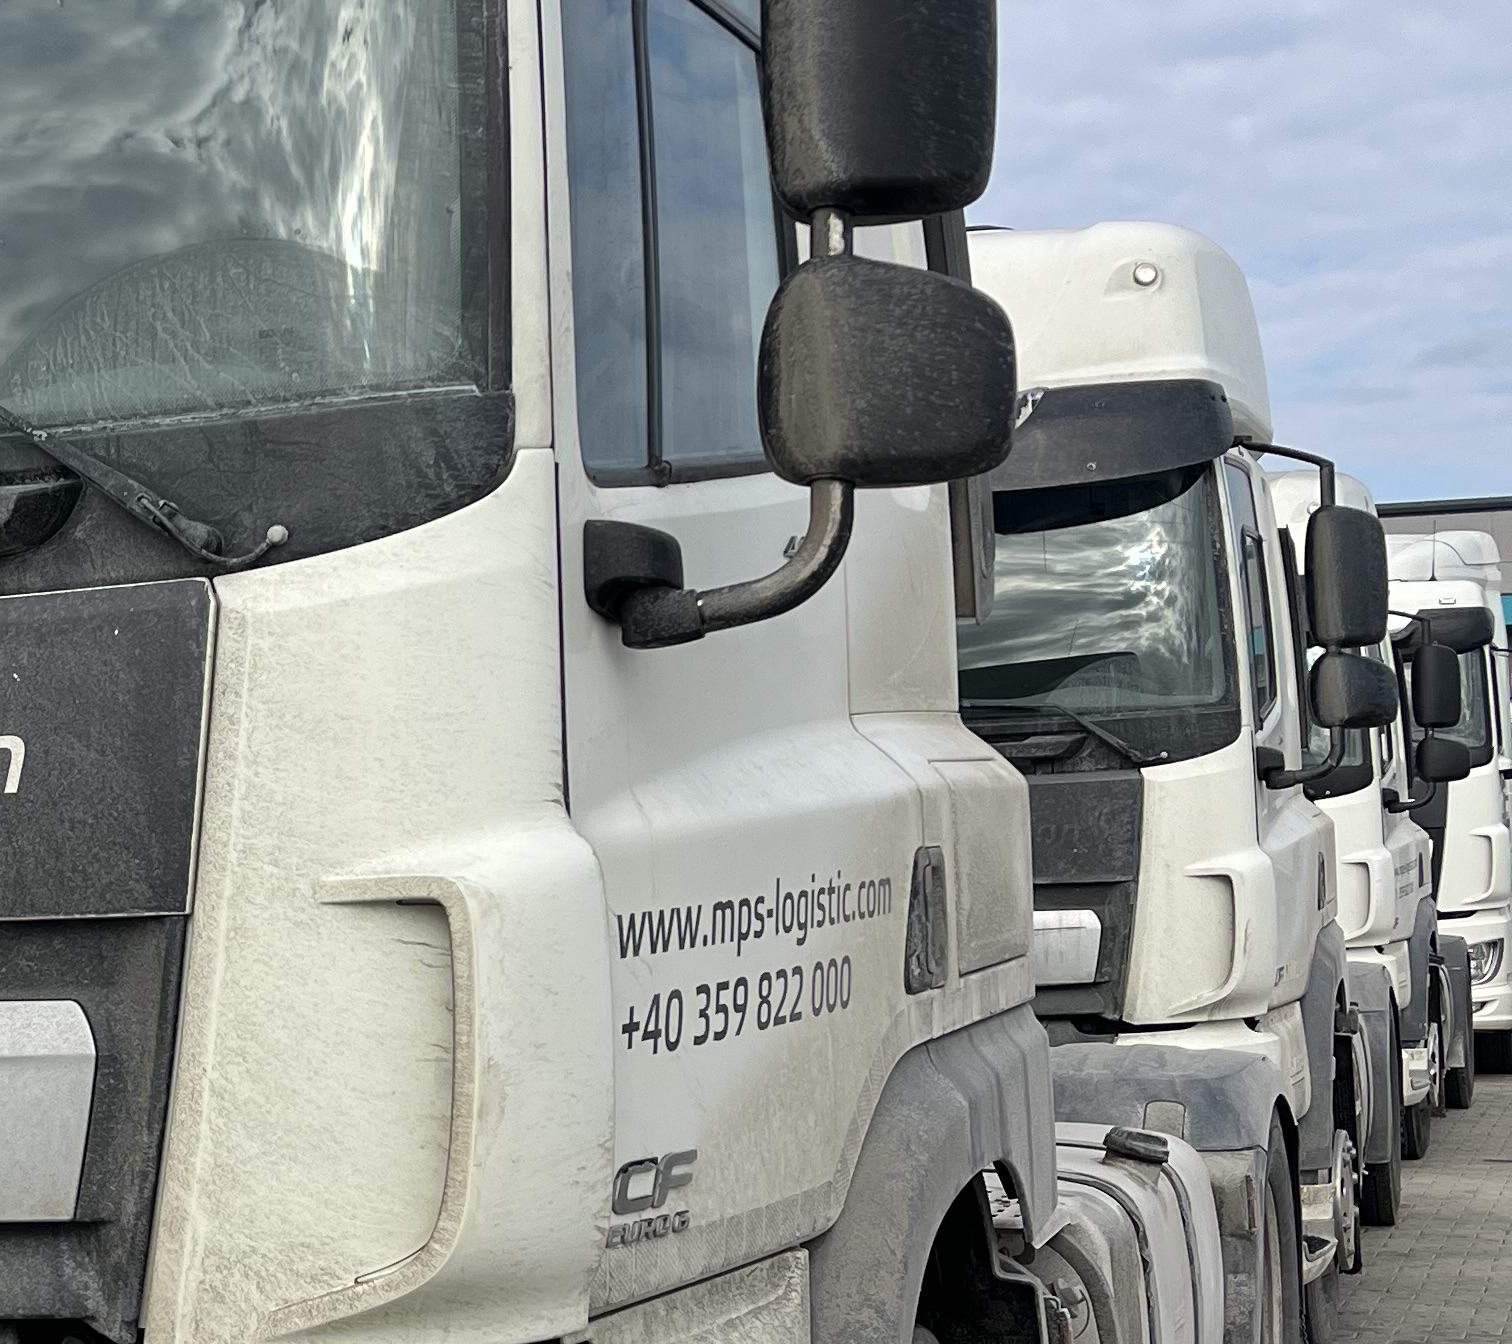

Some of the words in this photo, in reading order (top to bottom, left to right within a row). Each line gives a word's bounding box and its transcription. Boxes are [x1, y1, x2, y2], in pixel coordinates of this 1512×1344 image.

[616, 869, 892, 959] www.mps-logistic.com
[621, 988, 684, 1055] +40
[693, 976, 749, 1046] 359
[756, 965, 804, 1031] 822
[811, 955, 852, 1017] 000
[611, 1148, 698, 1215] CF
